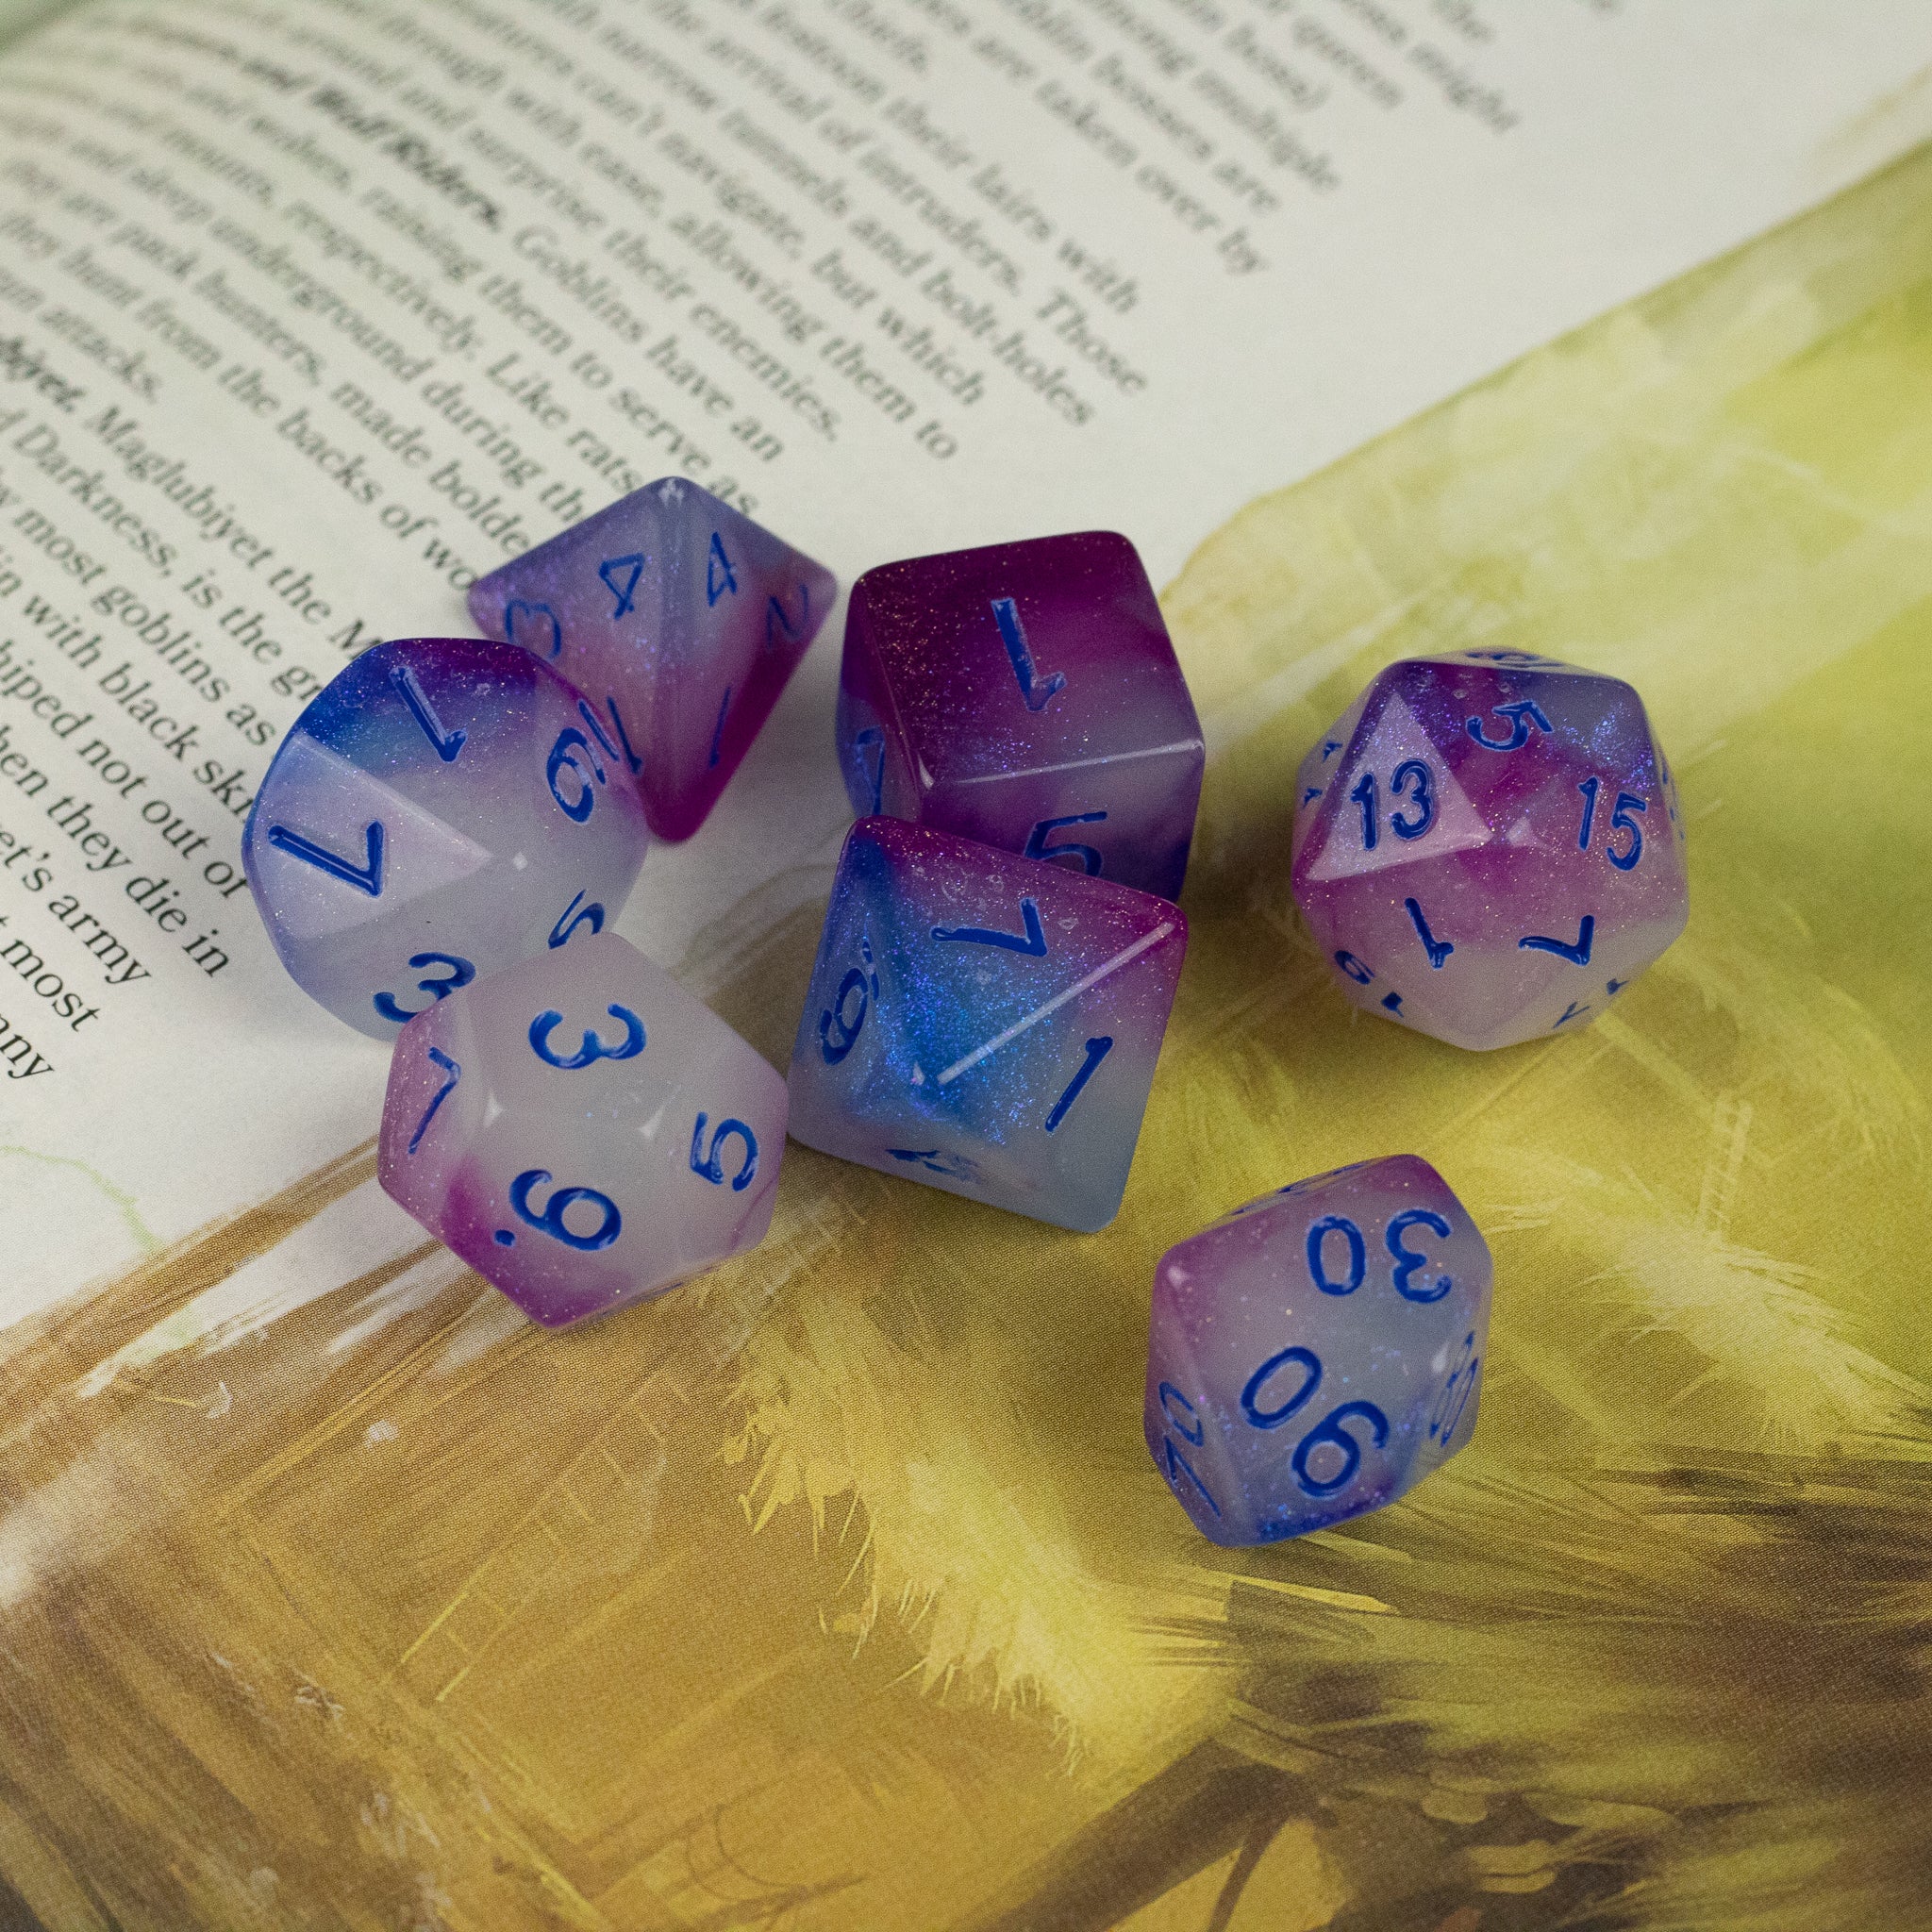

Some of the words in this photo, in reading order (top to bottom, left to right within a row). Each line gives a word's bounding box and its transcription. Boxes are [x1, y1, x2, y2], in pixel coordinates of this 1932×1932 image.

[477, 274, 574, 357] them
[569, 349, 613, 391] to
[608, 388, 711, 470] serve
[484, 350, 571, 427] Like
[511, 225, 649, 345] Goblins
[644, 333, 736, 416] have
[728, 415, 786, 463] an
[688, 302, 841, 444] enemies.
[876, 307, 986, 408] which
[1035, 288, 1150, 395] Those
[216, 362, 282, 417] the
[275, 406, 384, 505] backs
[377, 502, 440, 541] of
[419, 379, 546, 490] during
[537, 478, 585, 524] th
[819, 335, 917, 425] them
[914, 419, 959, 461] to
[85, 403, 276, 571] Maglubiyet
[267, 566, 333, 626] the
[328, 380, 433, 468] made
[426, 458, 531, 557] bolde
[11, 422, 179, 578] Darkness,
[180, 568, 224, 610] is
[217, 605, 283, 664] the
[706, 530, 738, 608] 4
[11, 508, 108, 587] most
[90, 584, 232, 704] goblins
[224, 702, 275, 749] as
[990, 596, 1068, 712] 1
[22, 594, 104, 670] with
[96, 661, 200, 764] black
[192, 757, 255, 824] ski
[76, 737, 148, 800] not
[140, 797, 210, 860] out
[1350, 758, 1437, 852] 13
[1576, 774, 1648, 873] 15
[45, 794, 133, 874] they
[125, 874, 189, 934] die
[180, 928, 230, 978] in
[267, 820, 385, 899] 7
[47, 893, 153, 986] army
[929, 896, 1048, 958] 7
[0, 938, 102, 1033] most
[526, 1002, 648, 1071] 3
[1044, 1035, 1114, 1133] 1
[690, 1110, 759, 1192] 5
[1305, 1208, 1454, 1305] 30
